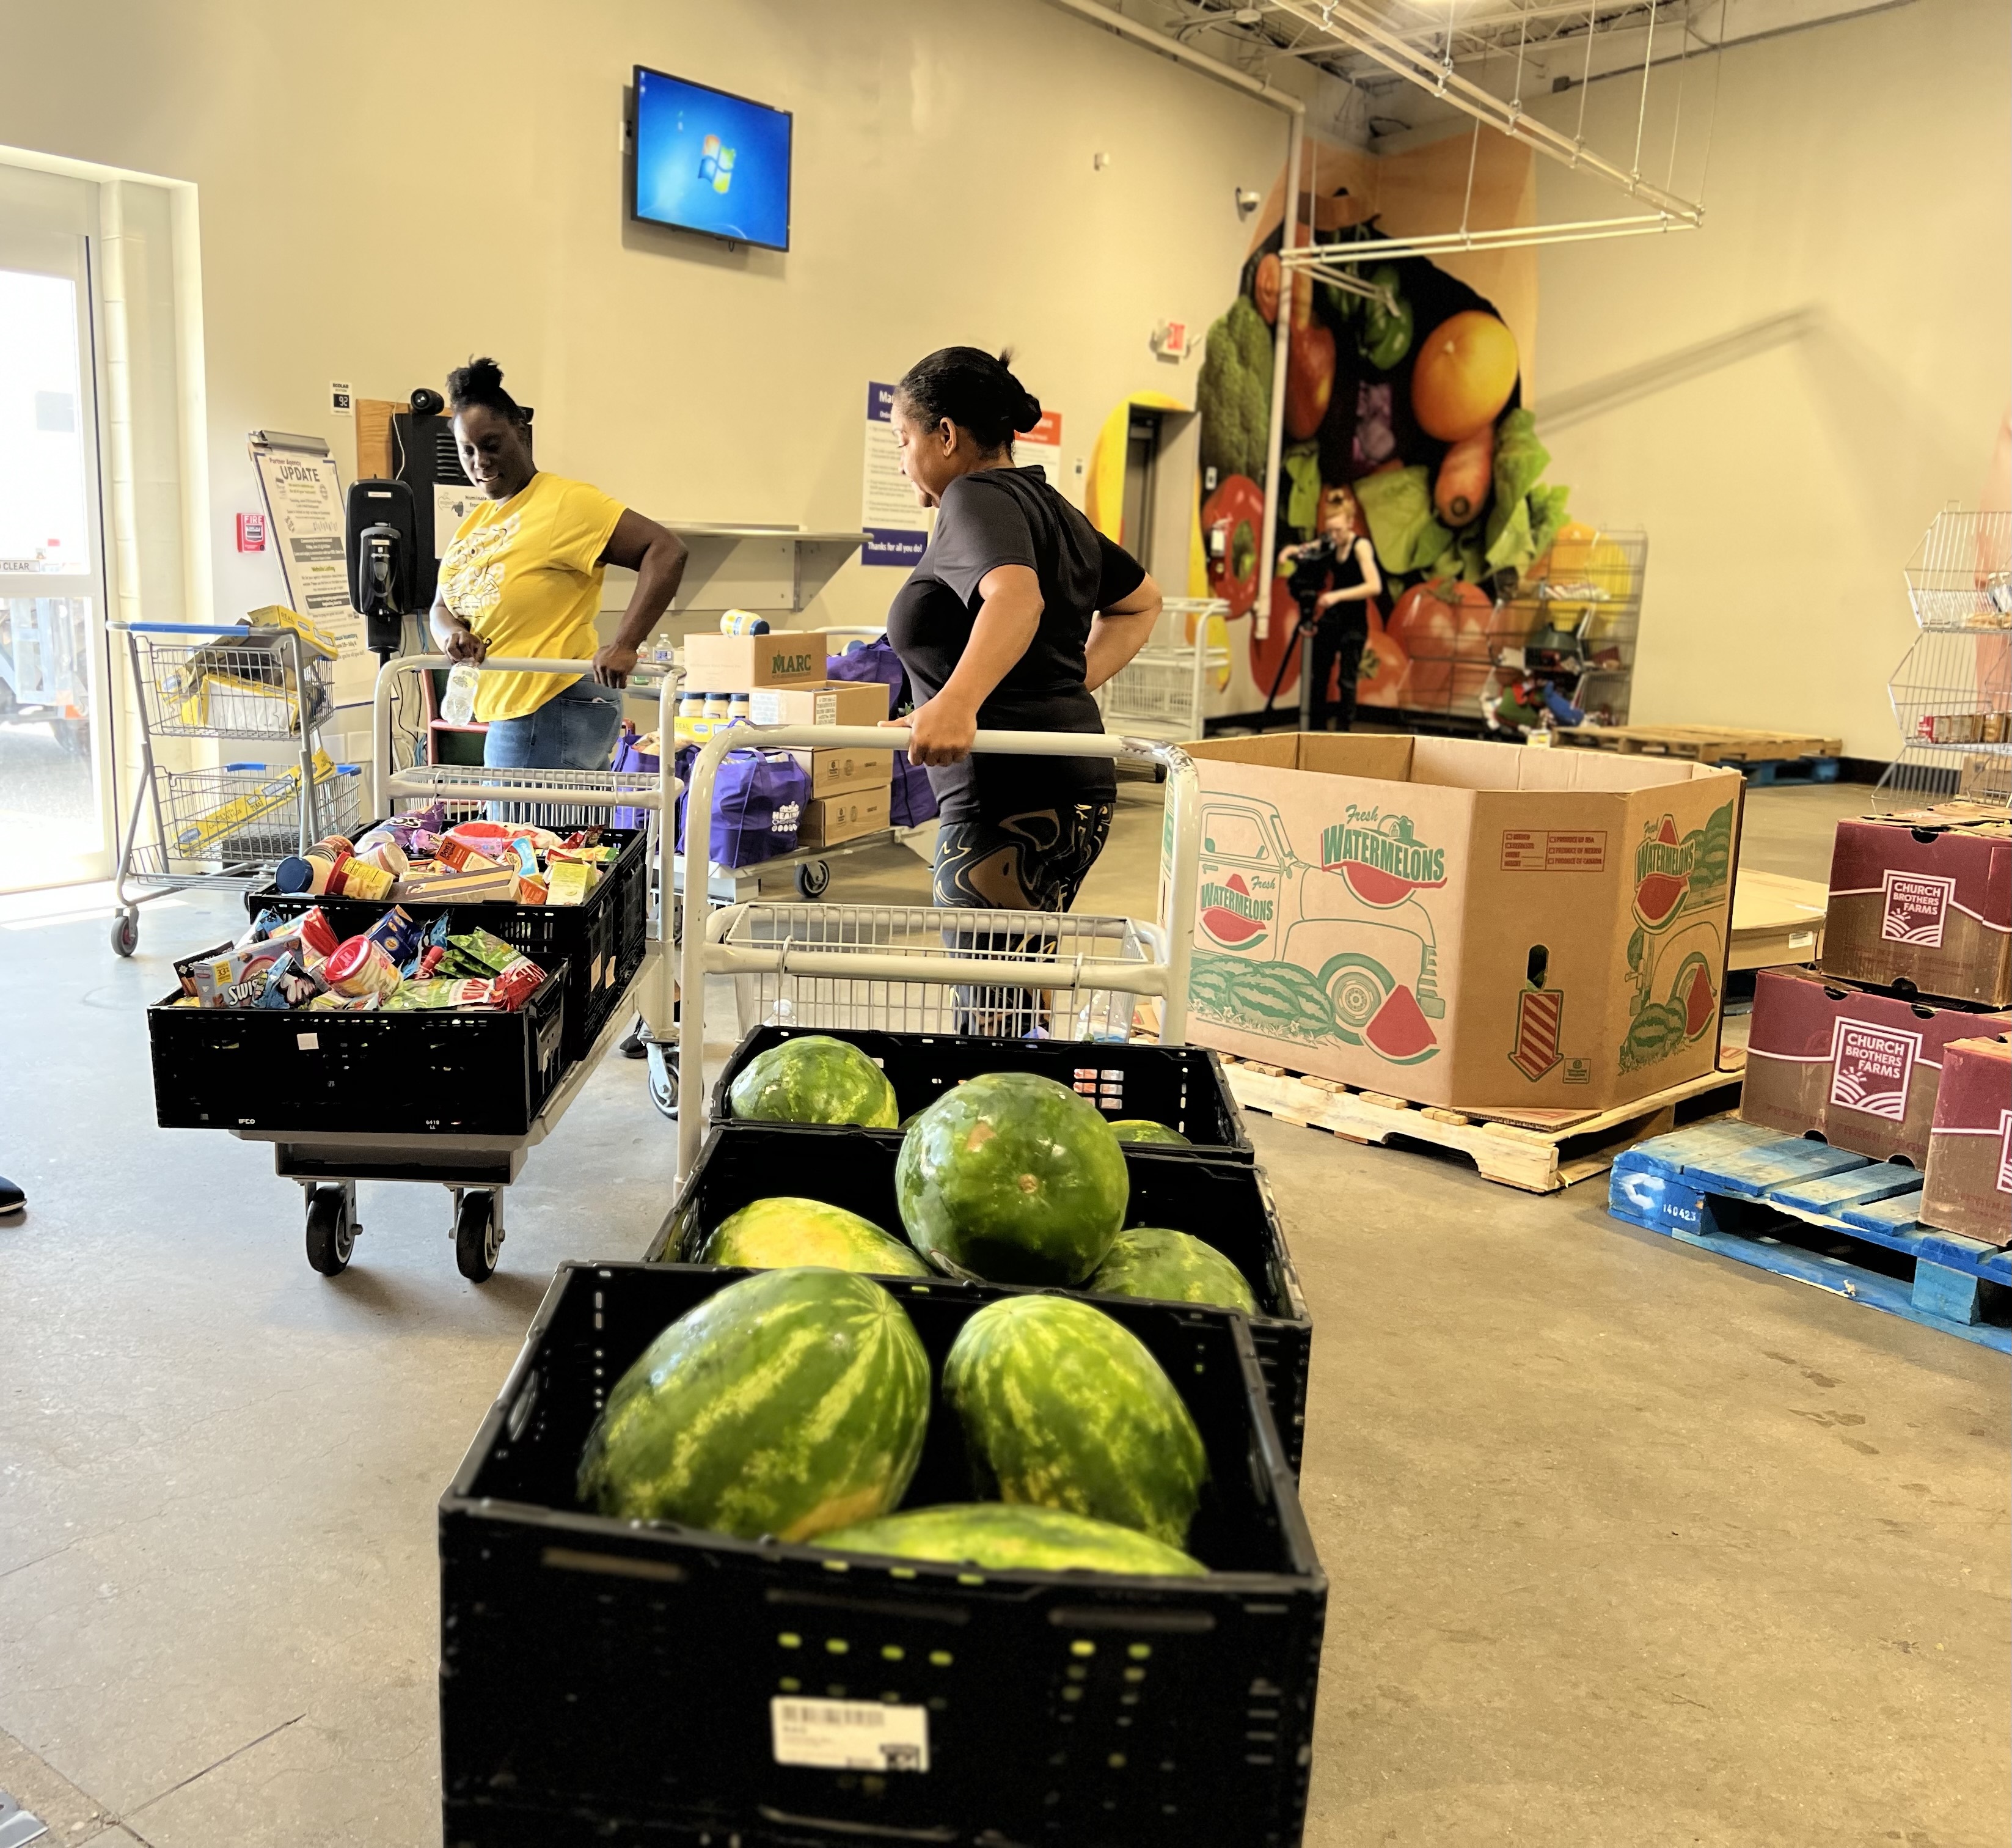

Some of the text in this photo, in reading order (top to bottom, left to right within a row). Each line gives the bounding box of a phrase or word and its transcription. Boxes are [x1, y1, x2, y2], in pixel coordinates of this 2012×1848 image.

[338, 396, 348, 406] 92
[286, 459, 302, 468] Agency
[280, 466, 320, 482] UPDATE
[244, 515, 263, 524] FIRE
[868, 541, 887, 551] Thanks
[902, 545, 913, 554] you
[3, 562, 30, 571] CLEAR
[772, 653, 811, 674] MARC
[1345, 804, 1379, 824] Fresh
[1323, 823, 1445, 881] WATERMELONS
[1637, 842, 1694, 883] WATERMELONS
[1251, 876, 1276, 890] Fresh
[1894, 882, 1941, 897] CHURCH
[1201, 882, 1273, 921] WATERMELONS
[1893, 892, 1939, 906] BROTHERS
[1903, 903, 1937, 915] FARMS
[1847, 1033, 1904, 1056] CHURCH
[1845, 1046, 1902, 1066] BROTHERS
[1858, 1060, 1900, 1079] FARMS
[1663, 1203, 1697, 1222] 140423
